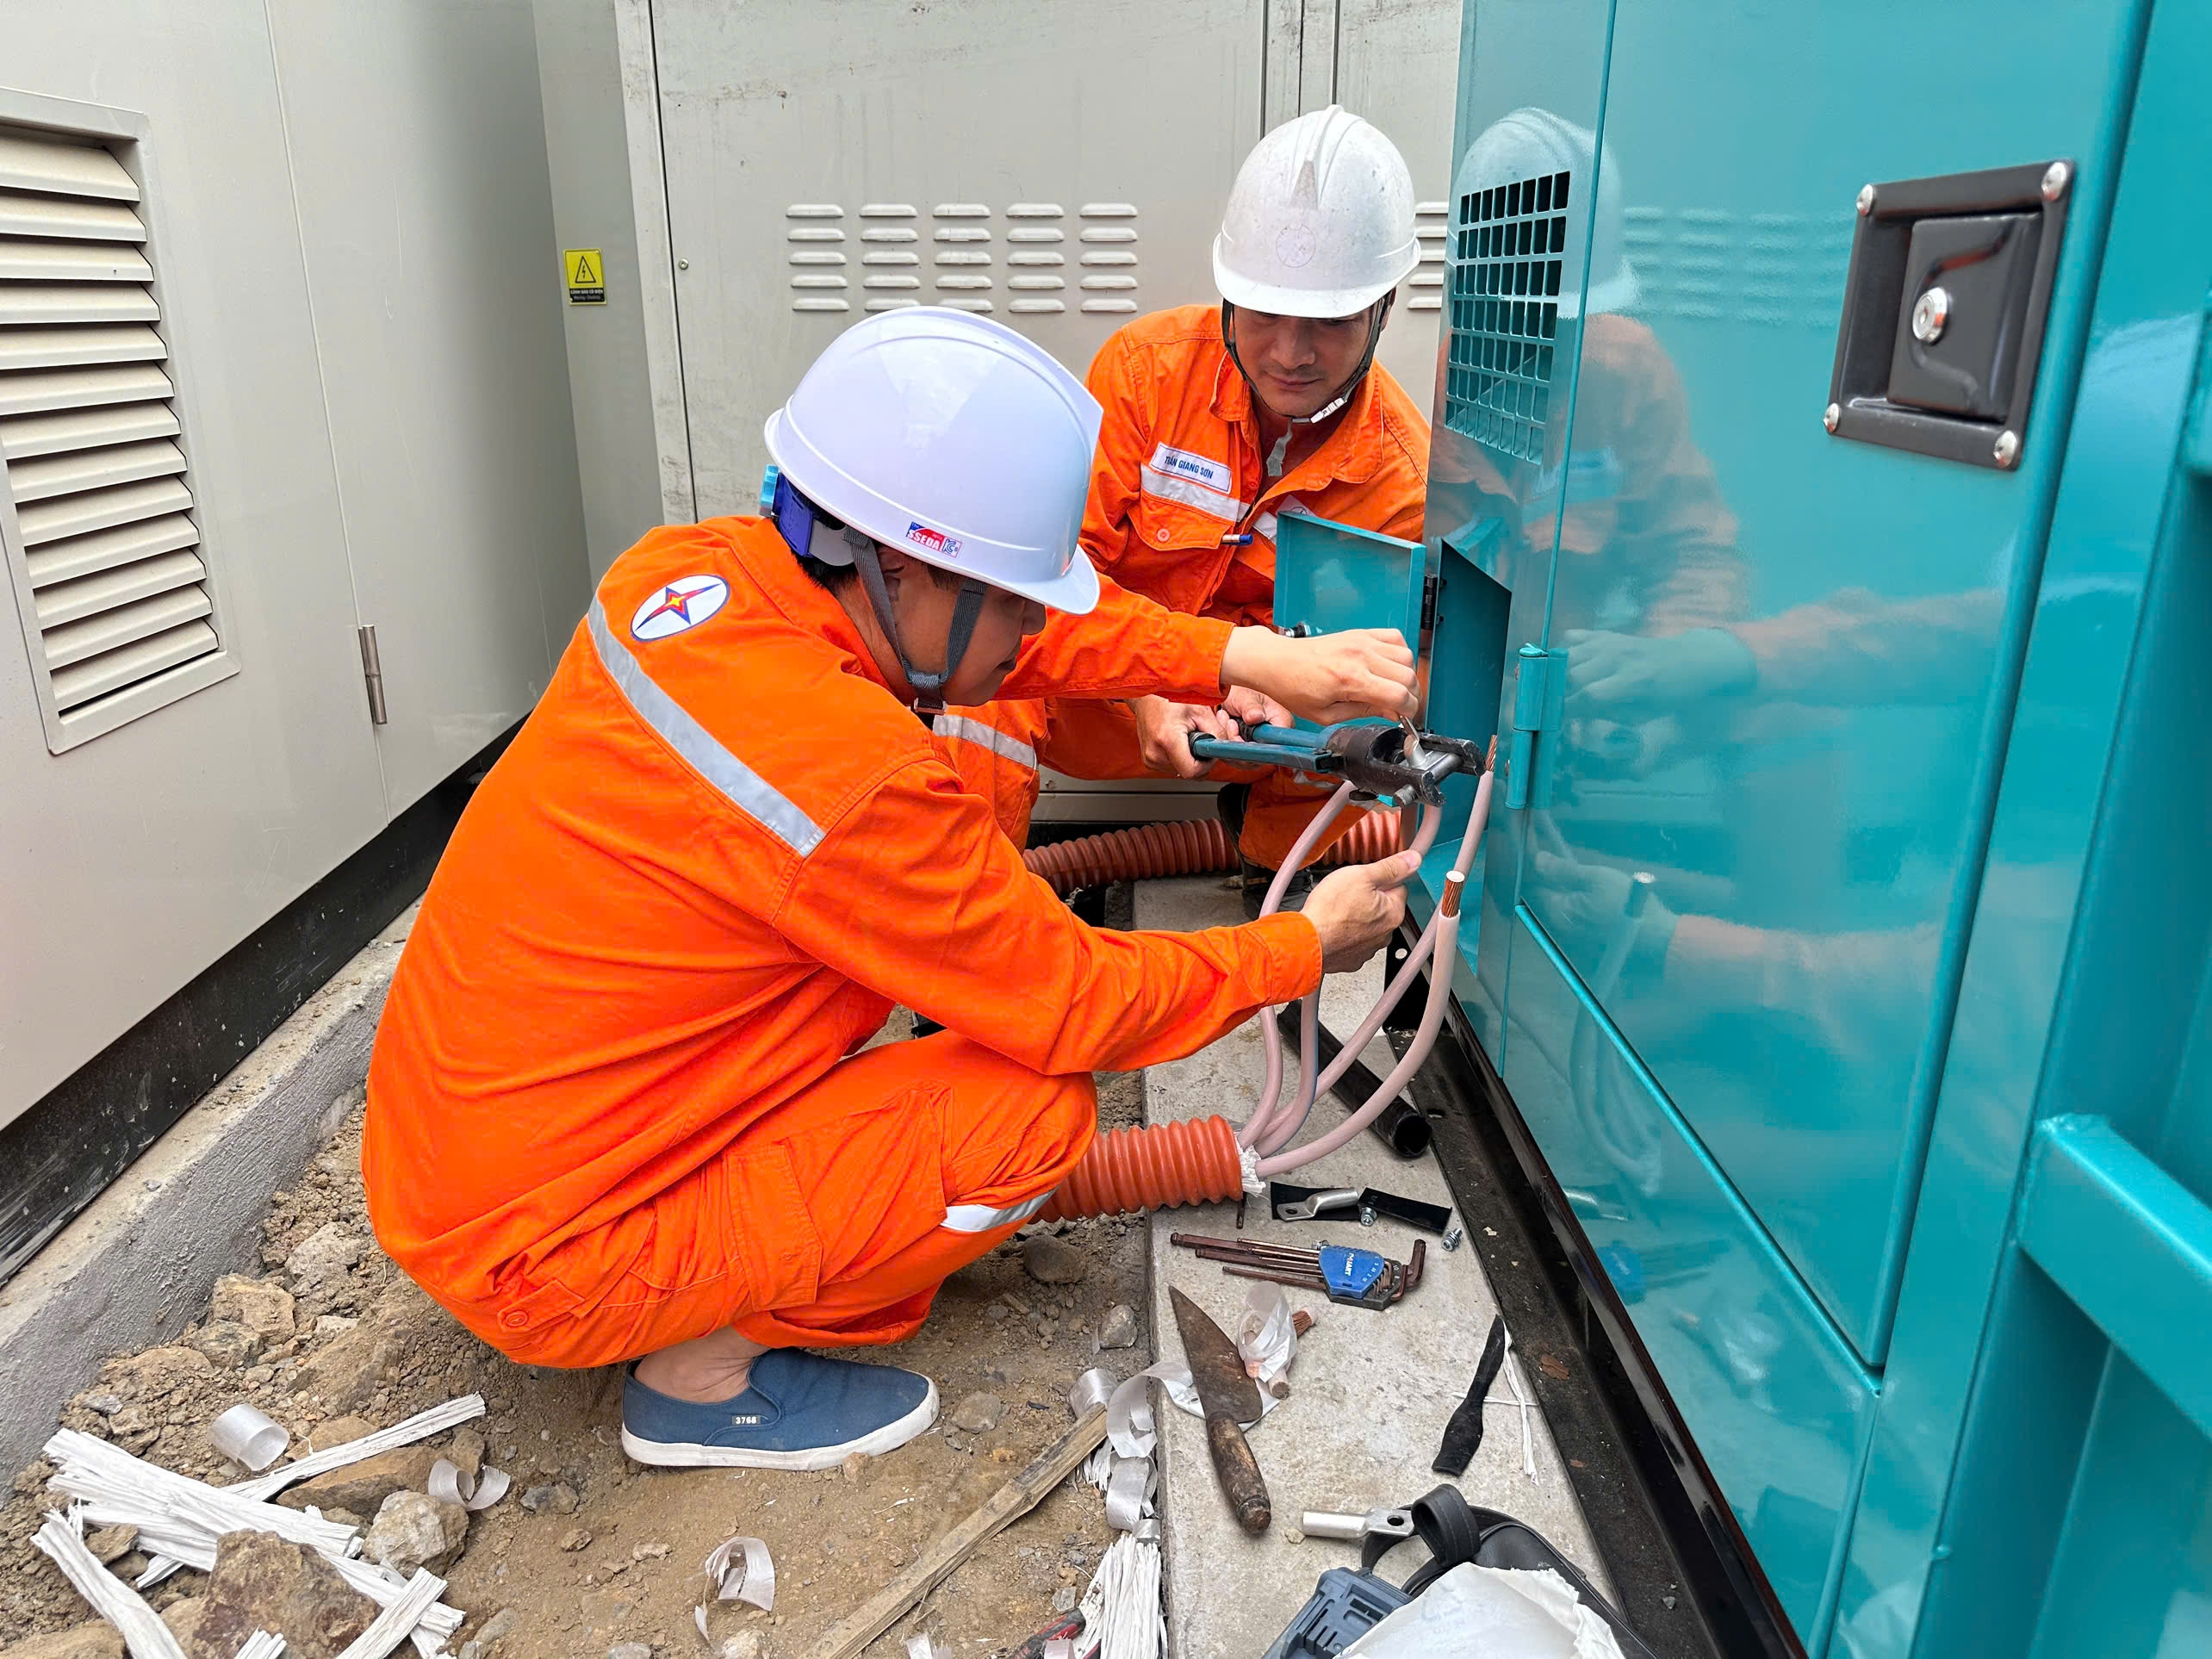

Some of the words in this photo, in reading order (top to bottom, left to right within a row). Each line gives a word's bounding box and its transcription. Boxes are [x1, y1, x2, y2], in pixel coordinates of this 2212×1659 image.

[1177, 459, 1199, 474] GIANG
[1200, 467, 1214, 479] SƠN
[907, 529, 941, 551] SSEDA
[735, 1416, 757, 1425] 3768
